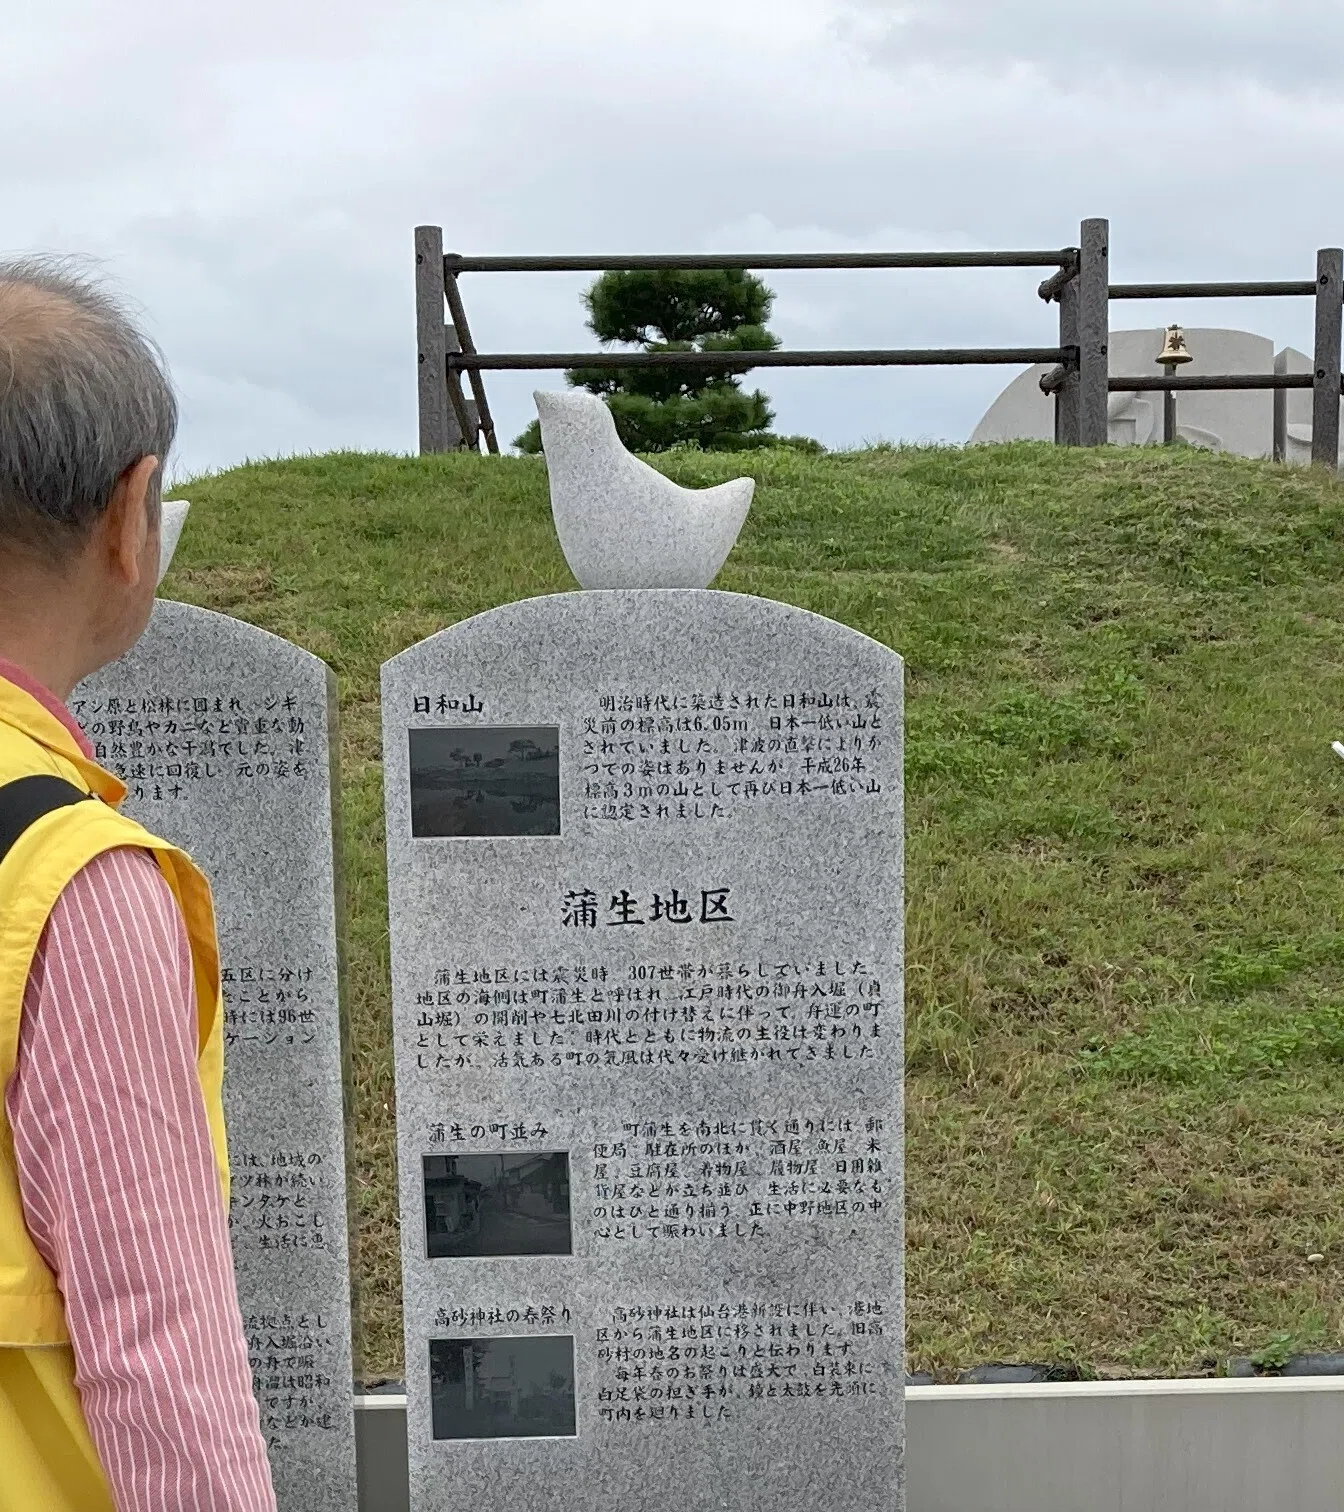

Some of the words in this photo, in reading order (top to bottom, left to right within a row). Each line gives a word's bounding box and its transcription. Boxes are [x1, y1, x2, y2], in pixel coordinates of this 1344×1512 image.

[412, 695, 484, 715] 日和山
[559, 887, 737, 928] 蒲生地区
[428, 1122, 548, 1142] 蒲生の町並み
[434, 1304, 572, 1327] 高砂神社の春祭り
